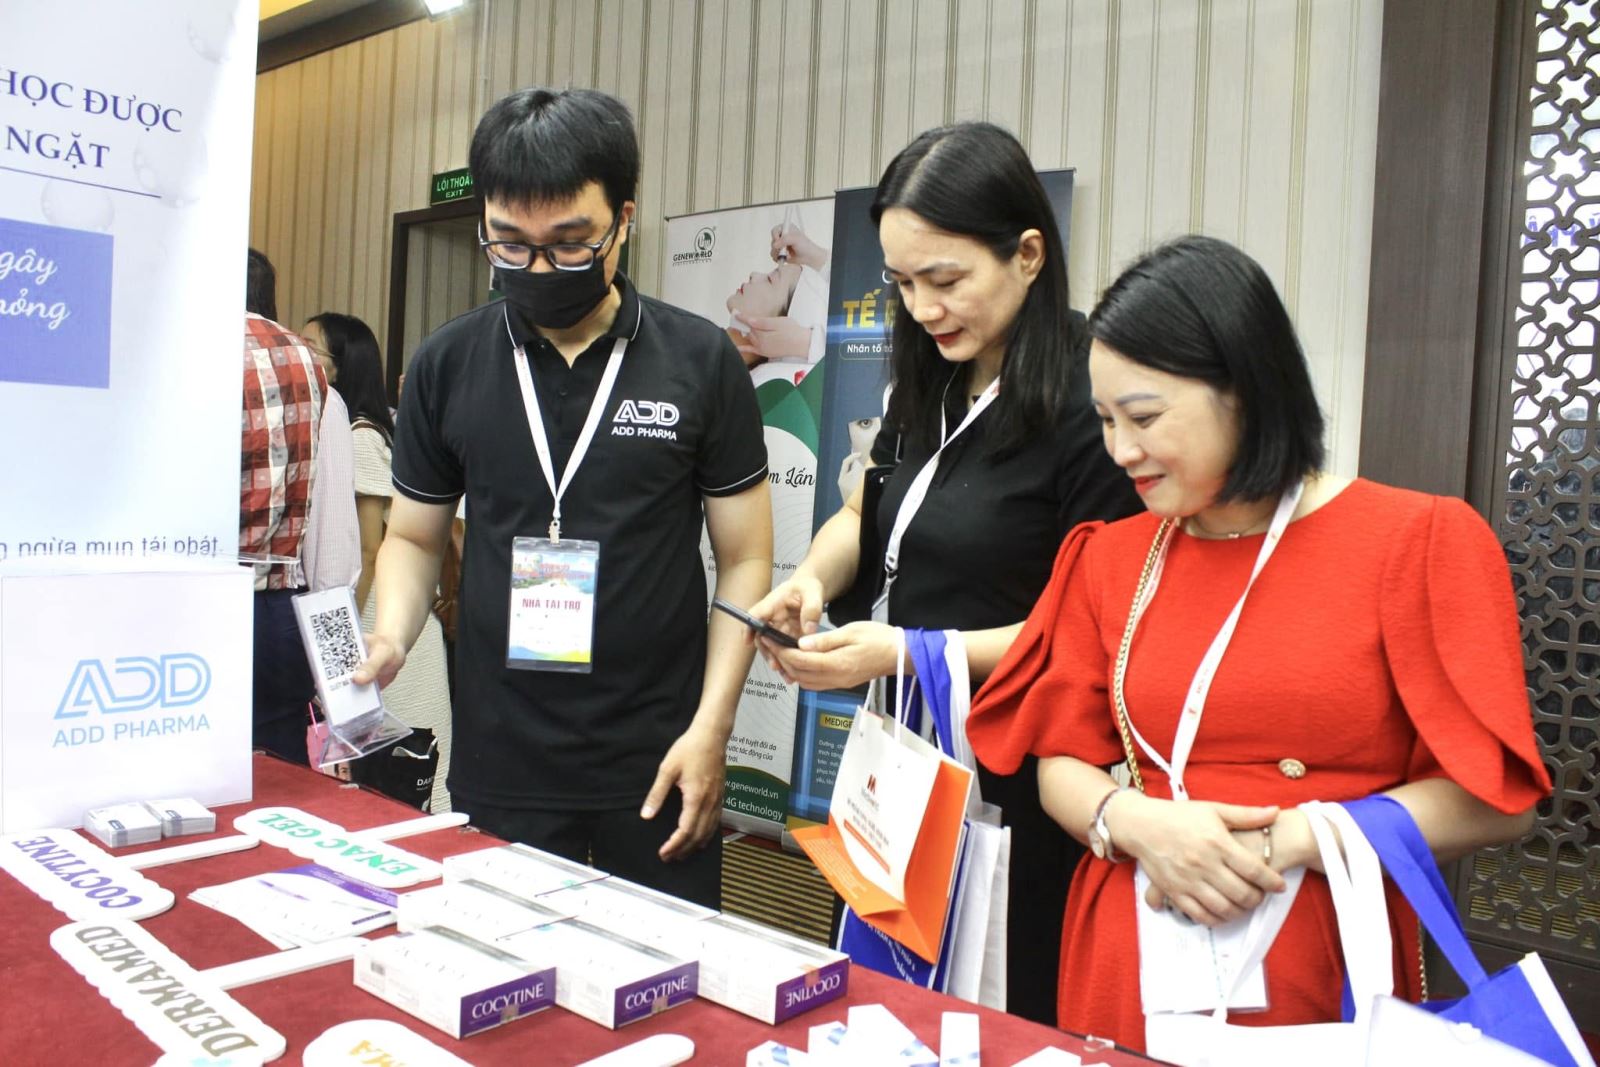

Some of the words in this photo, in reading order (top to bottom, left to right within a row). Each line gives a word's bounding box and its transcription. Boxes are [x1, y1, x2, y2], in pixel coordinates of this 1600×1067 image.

[83, 88, 183, 132] ĐƯỢC
[5, 125, 111, 170] NGẶT
[445, 189, 464, 198] EXIT
[842, 288, 882, 329] TẾ
[847, 343, 870, 353] Nhân
[872, 342, 882, 353] tố
[611, 425, 635, 436] ADD
[637, 427, 677, 441] PHARMA
[53, 652, 212, 720] ADD
[52, 725, 105, 748] ADD
[113, 713, 211, 741] PHARMA
[257, 813, 321, 839] GEL
[738, 800, 783, 821] technology
[11, 835, 143, 909] COCYTINE
[315, 838, 418, 876] ENAC
[75, 925, 259, 1057] DERMAMED
[472, 982, 544, 1019] COCYTINE
[624, 974, 689, 1011] COCYTINE
[784, 974, 841, 1009] COCYTINE
